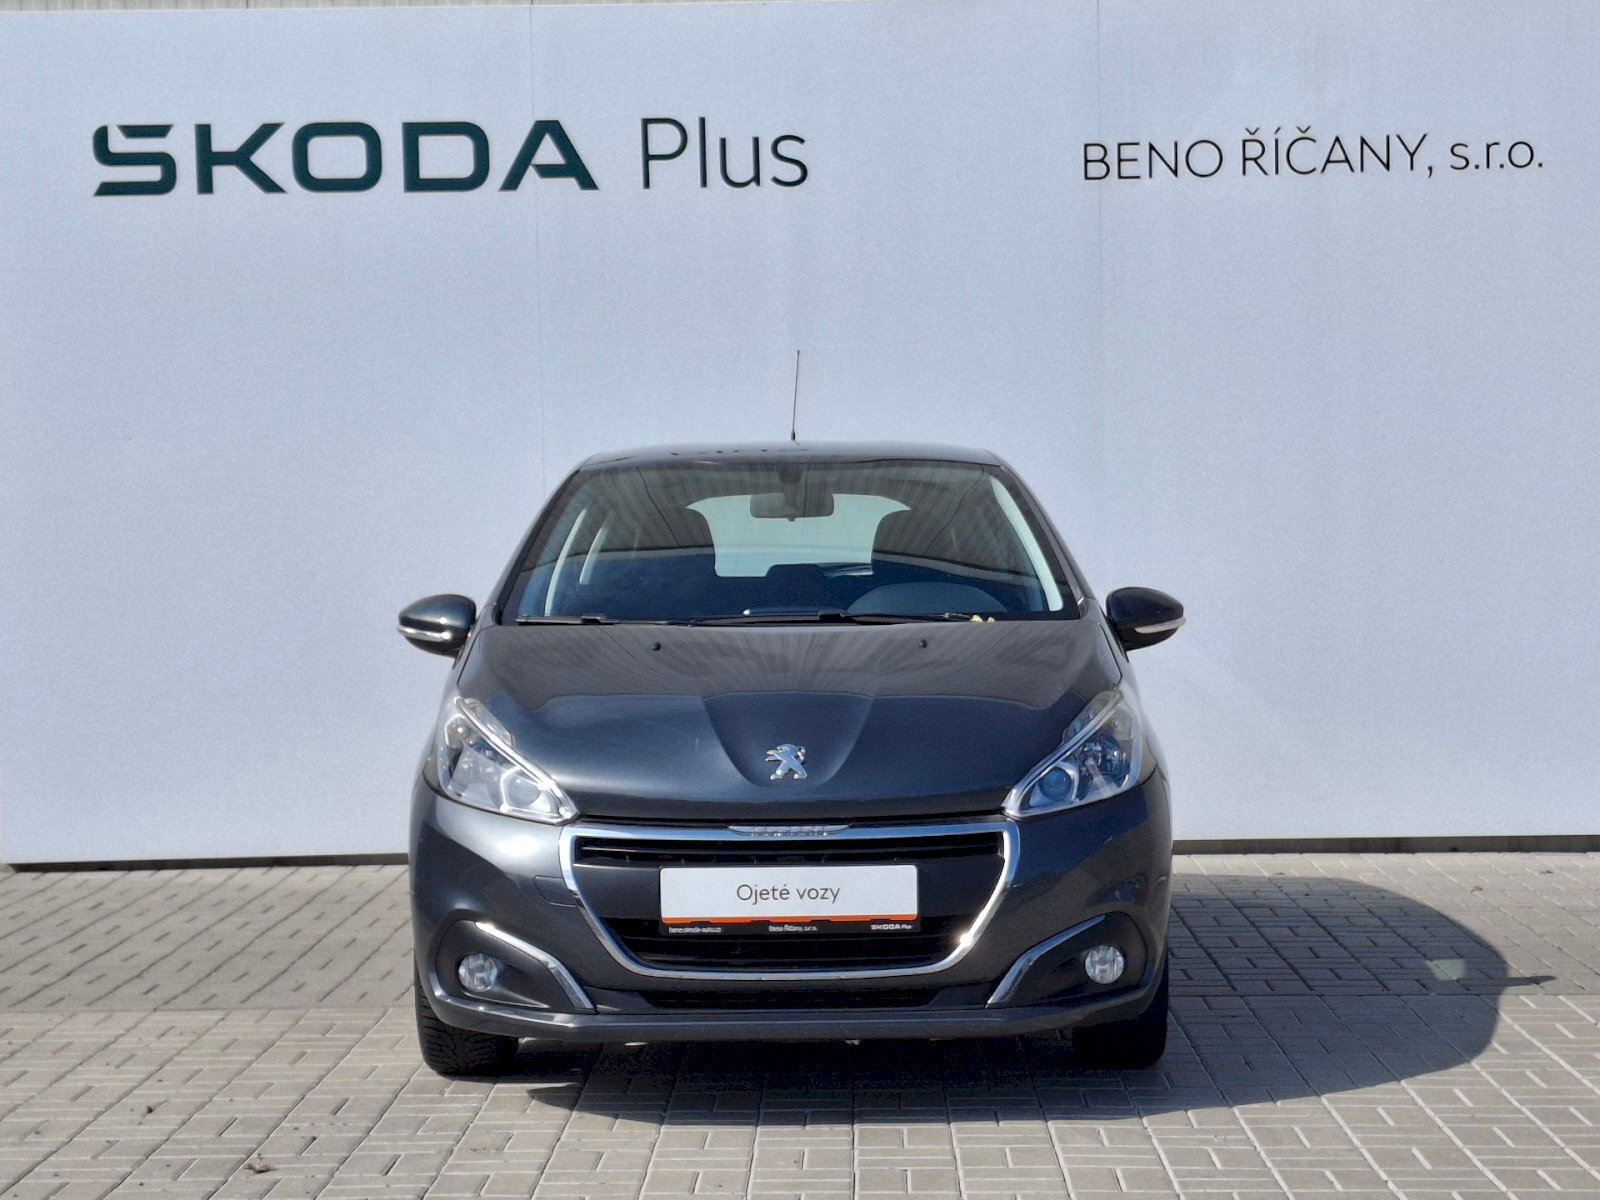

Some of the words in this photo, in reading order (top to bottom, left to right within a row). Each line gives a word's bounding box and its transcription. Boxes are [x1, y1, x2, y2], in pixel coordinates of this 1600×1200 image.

[641, 117, 809, 190] Plus
[1083, 140, 1224, 181] BENO
[1241, 126, 1433, 179] ŘÍČANY,
[1449, 141, 1543, 171] s.r.o.
[736, 884, 790, 905] Ojeté
[796, 887, 841, 905] vozy
